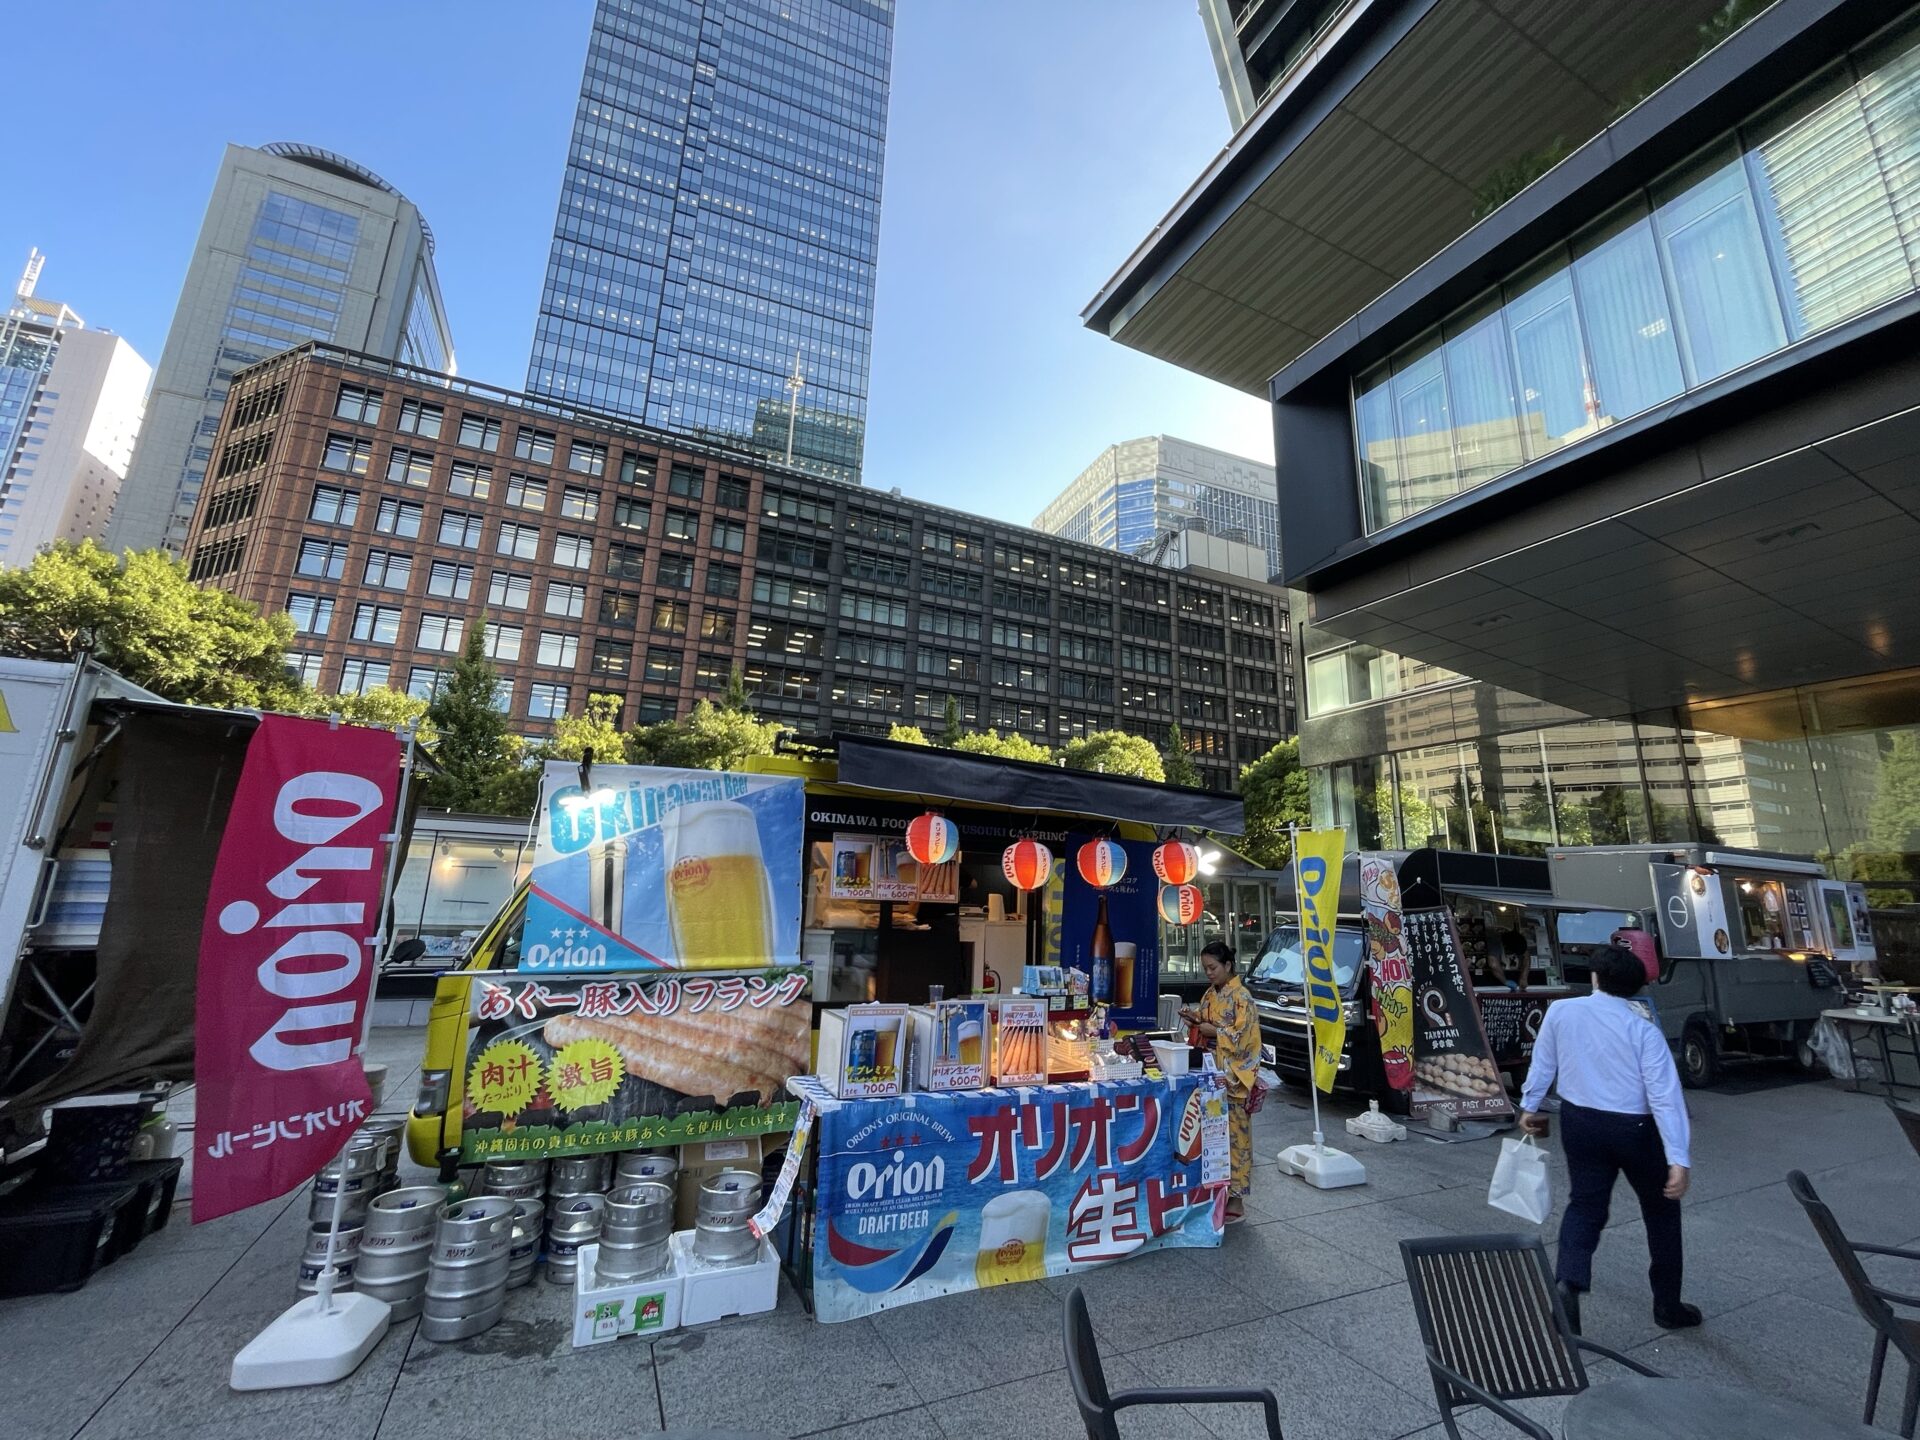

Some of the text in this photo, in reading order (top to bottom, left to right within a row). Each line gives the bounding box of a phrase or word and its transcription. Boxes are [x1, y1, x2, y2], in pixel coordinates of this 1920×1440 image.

[549, 774, 749, 854] Okinawan Beer
[811, 811, 877, 828] OKINAWA
[881, 818, 911, 829] FOO
[1009, 827, 1069, 842] CATERING
[1003, 847, 1016, 879] Orion
[1153, 850, 1166, 878] Orion
[1180, 889, 1192, 917] Orion
[527, 938, 606, 968] Orion
[1300, 856, 1339, 1023] Orion
[1381, 957, 1412, 983] HOT
[478, 974, 807, 1020] あぐー豚入りフランク
[1423, 1028, 1460, 1040] TAKOYAKI
[481, 1055, 534, 1088] 肉汁
[558, 1056, 614, 1091] 激旨
[932, 1065, 983, 1077] オリオン生ビール
[949, 1076, 981, 1087] 600円
[863, 1082, 898, 1094] 700円
[1461, 1101, 1480, 1109] FAST
[1484, 1098, 1504, 1108] FOOD
[474, 1111, 795, 1154] 沖縄固有の貴重な在来豚あぐーを使用しています。
[846, 1111, 956, 1149] ORION'S ORIGINAL BREW
[967, 1093, 1162, 1185] オリオン
[847, 1150, 945, 1200] Orion
[709, 1215, 734, 1224] オリオン
[859, 1209, 929, 1235] DRAFT BEER
[445, 1247, 475, 1257] オリオン
